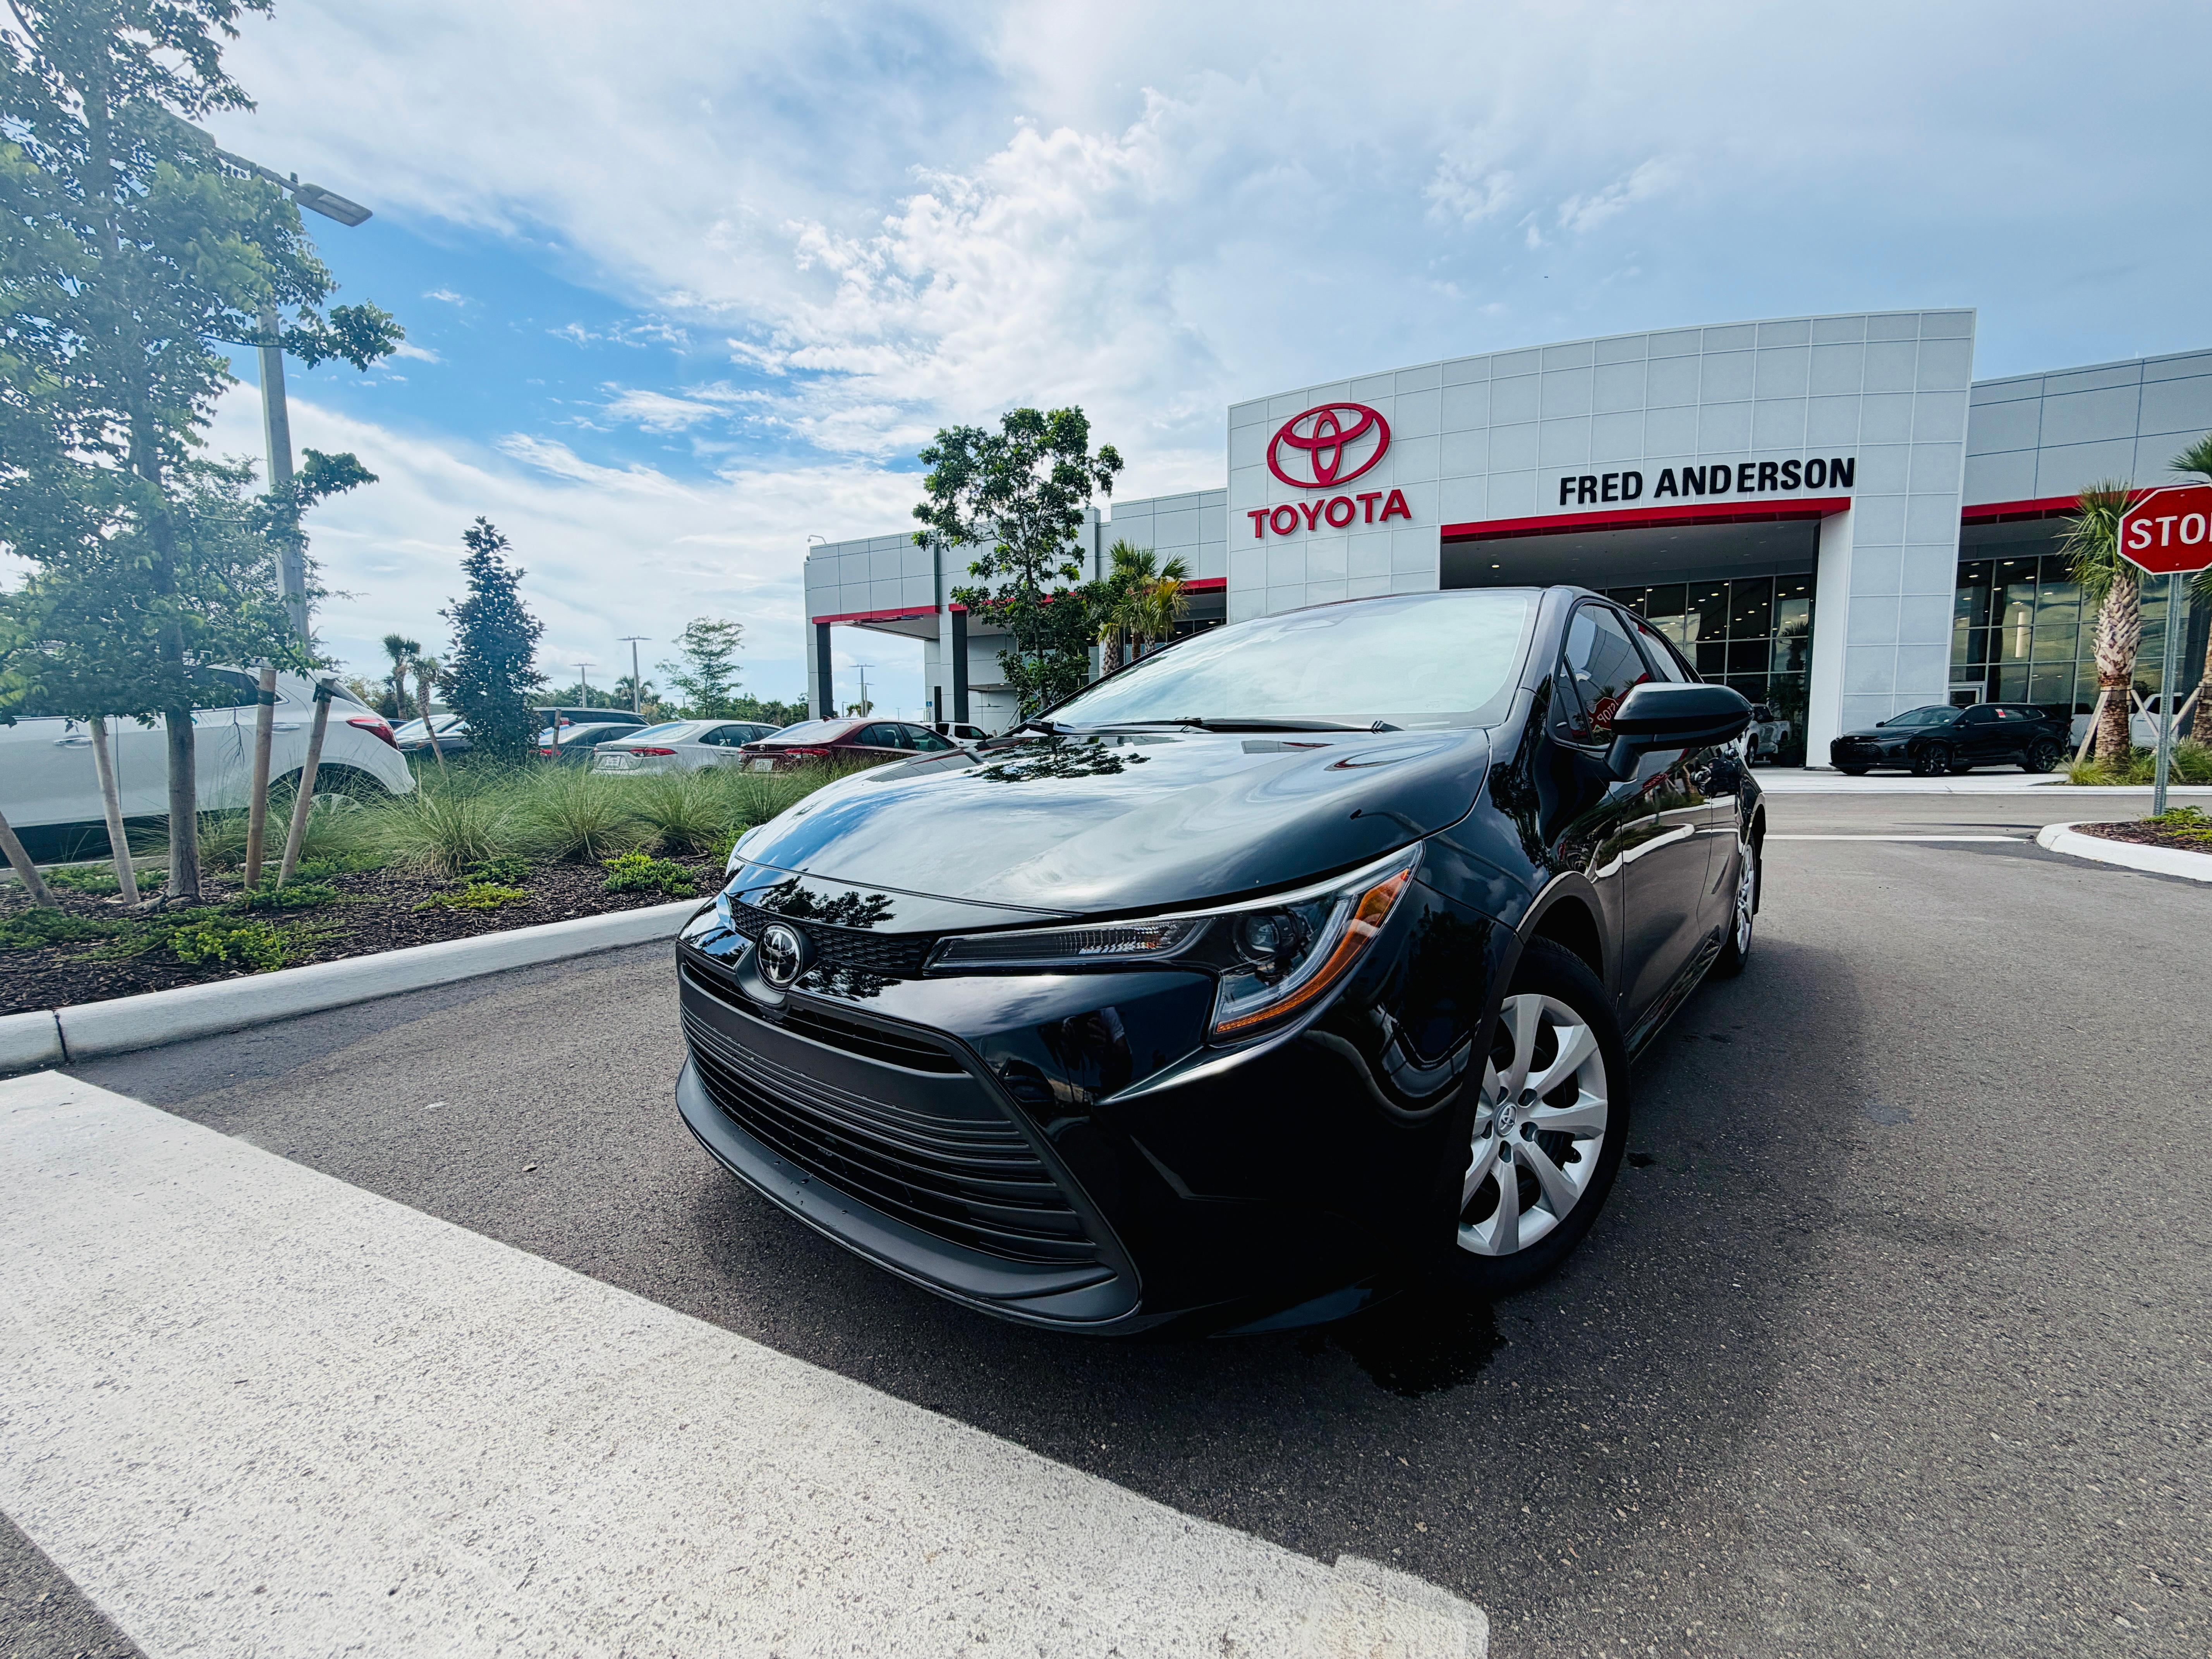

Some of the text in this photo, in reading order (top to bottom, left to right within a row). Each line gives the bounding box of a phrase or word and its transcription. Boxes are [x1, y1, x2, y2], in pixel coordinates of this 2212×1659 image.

[1559, 457, 1855, 506] FRED ANDERSON
[1247, 489, 1412, 538] TOYOTA
[2128, 512, 2212, 550] STO
